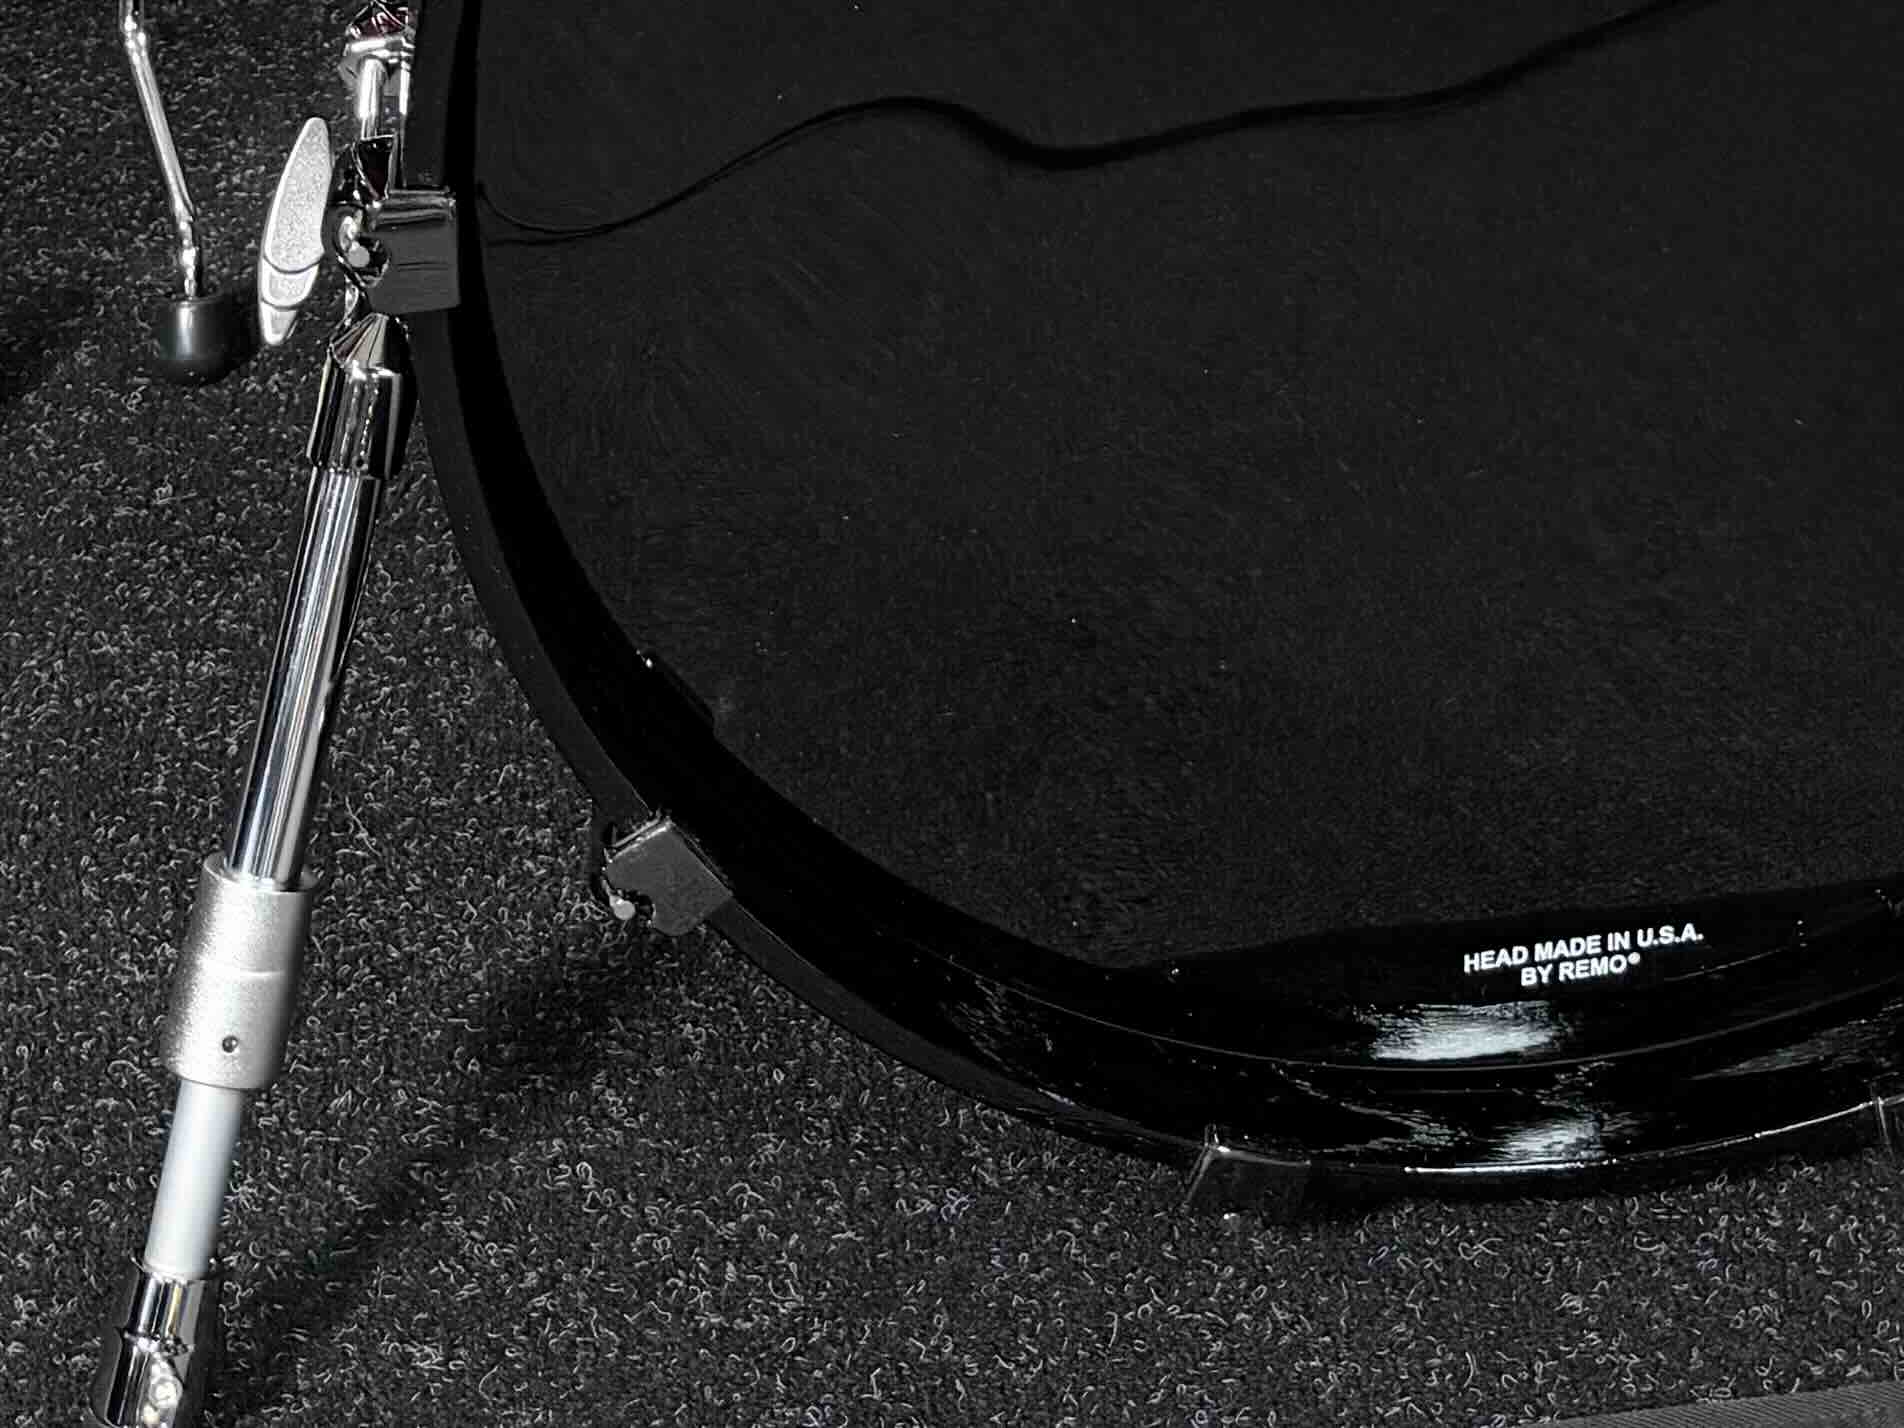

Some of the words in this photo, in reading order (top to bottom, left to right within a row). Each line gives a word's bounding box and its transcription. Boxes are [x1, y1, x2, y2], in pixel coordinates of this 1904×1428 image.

[1463, 946, 1528, 973] HEAD
[1534, 934, 1602, 962] MADE
[1607, 930, 1631, 951] IN
[1637, 923, 1704, 947] U.S.A.
[1521, 964, 1553, 987] BY
